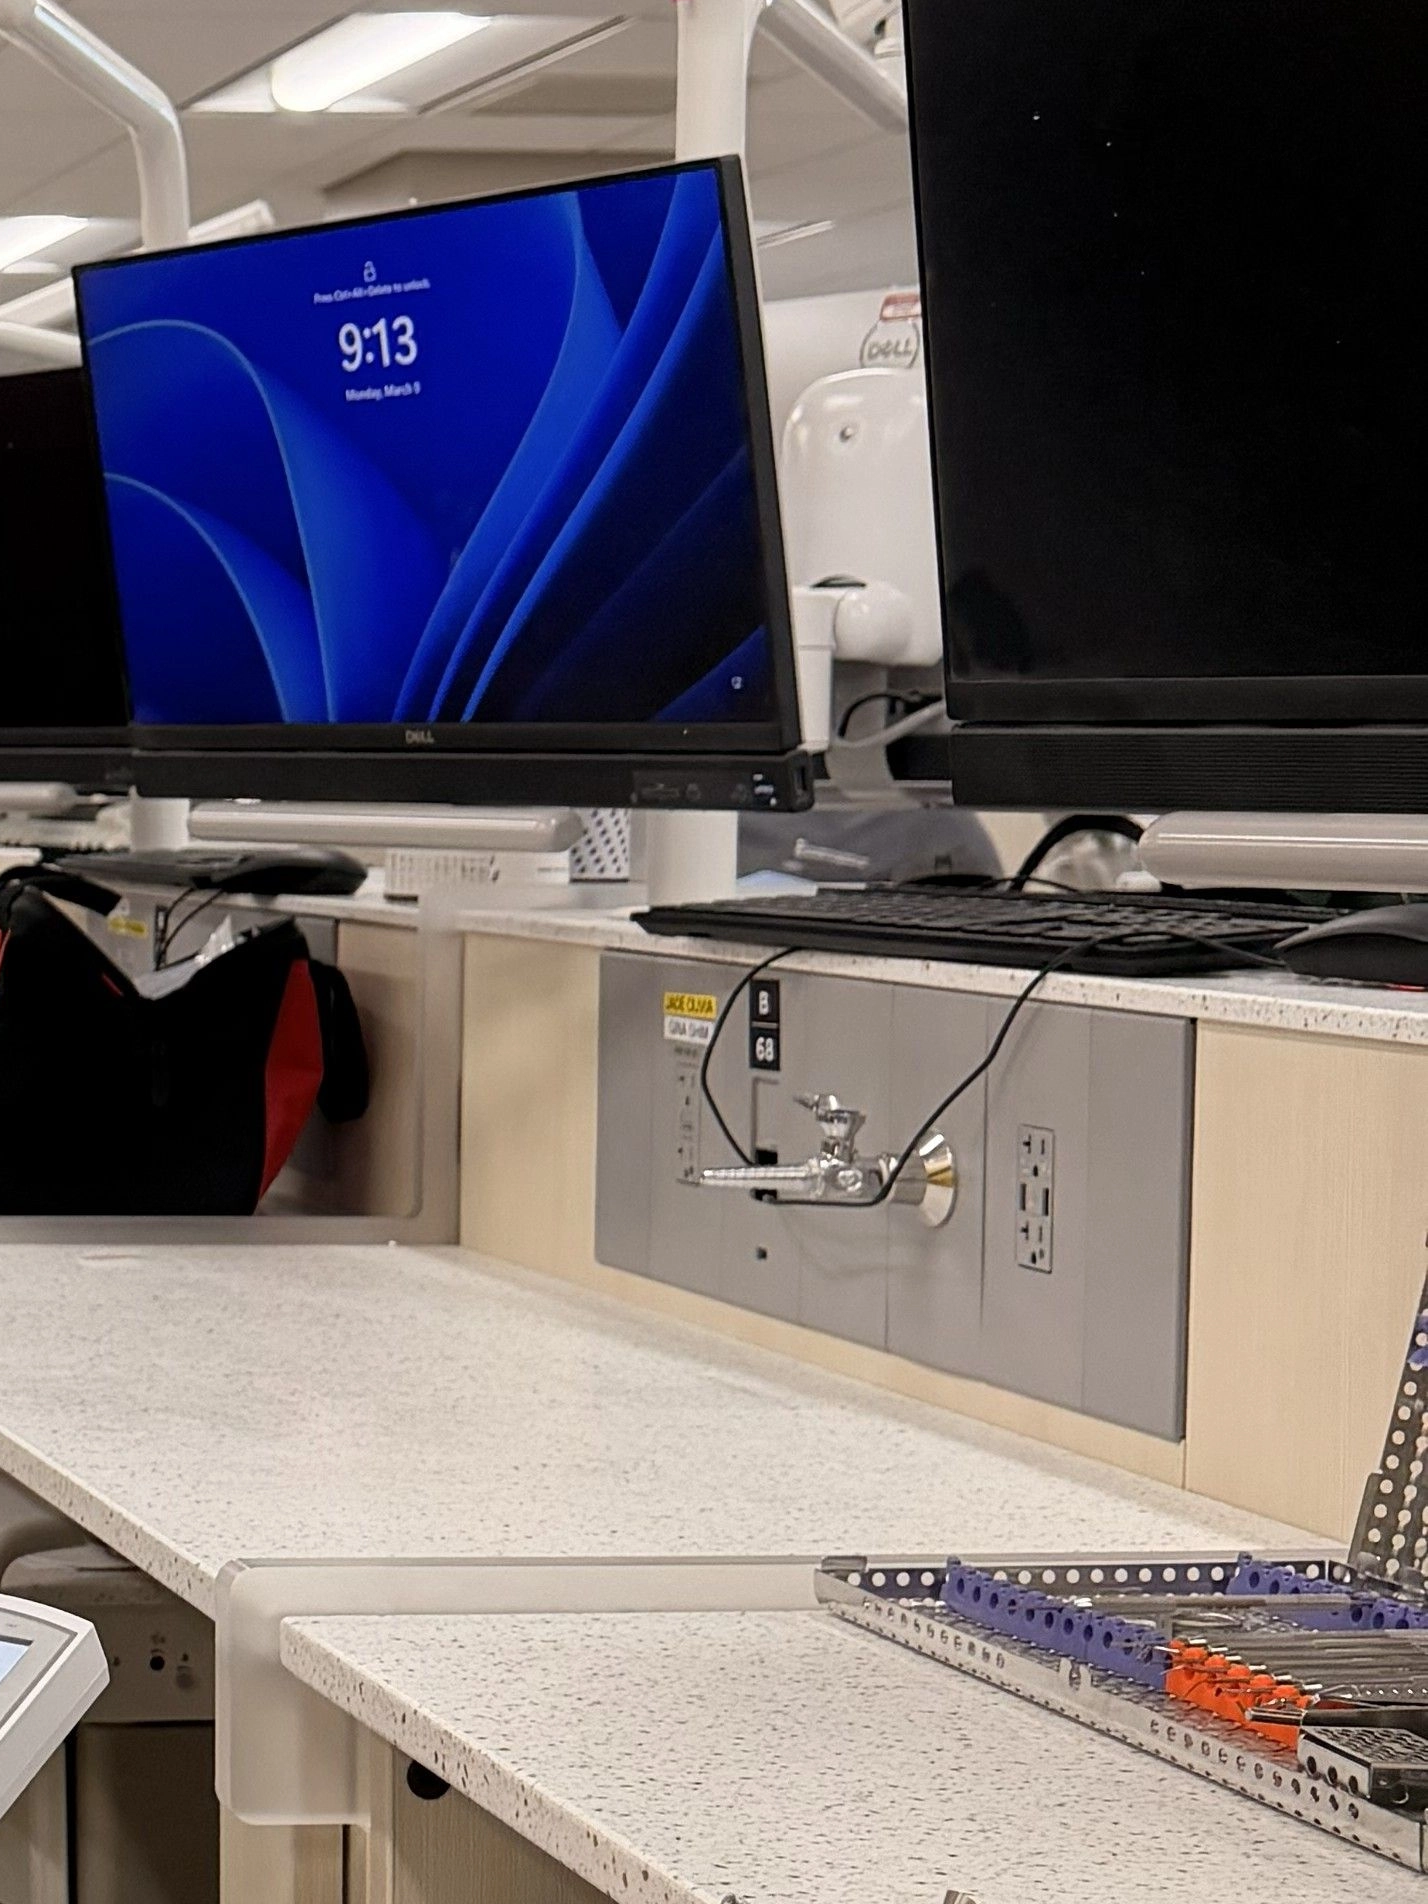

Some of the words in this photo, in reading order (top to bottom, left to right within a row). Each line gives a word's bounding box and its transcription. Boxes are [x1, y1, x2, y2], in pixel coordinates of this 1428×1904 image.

[338, 315, 418, 372] 9:13
[758, 989, 770, 1016] B
[755, 1036, 775, 1062] 68
